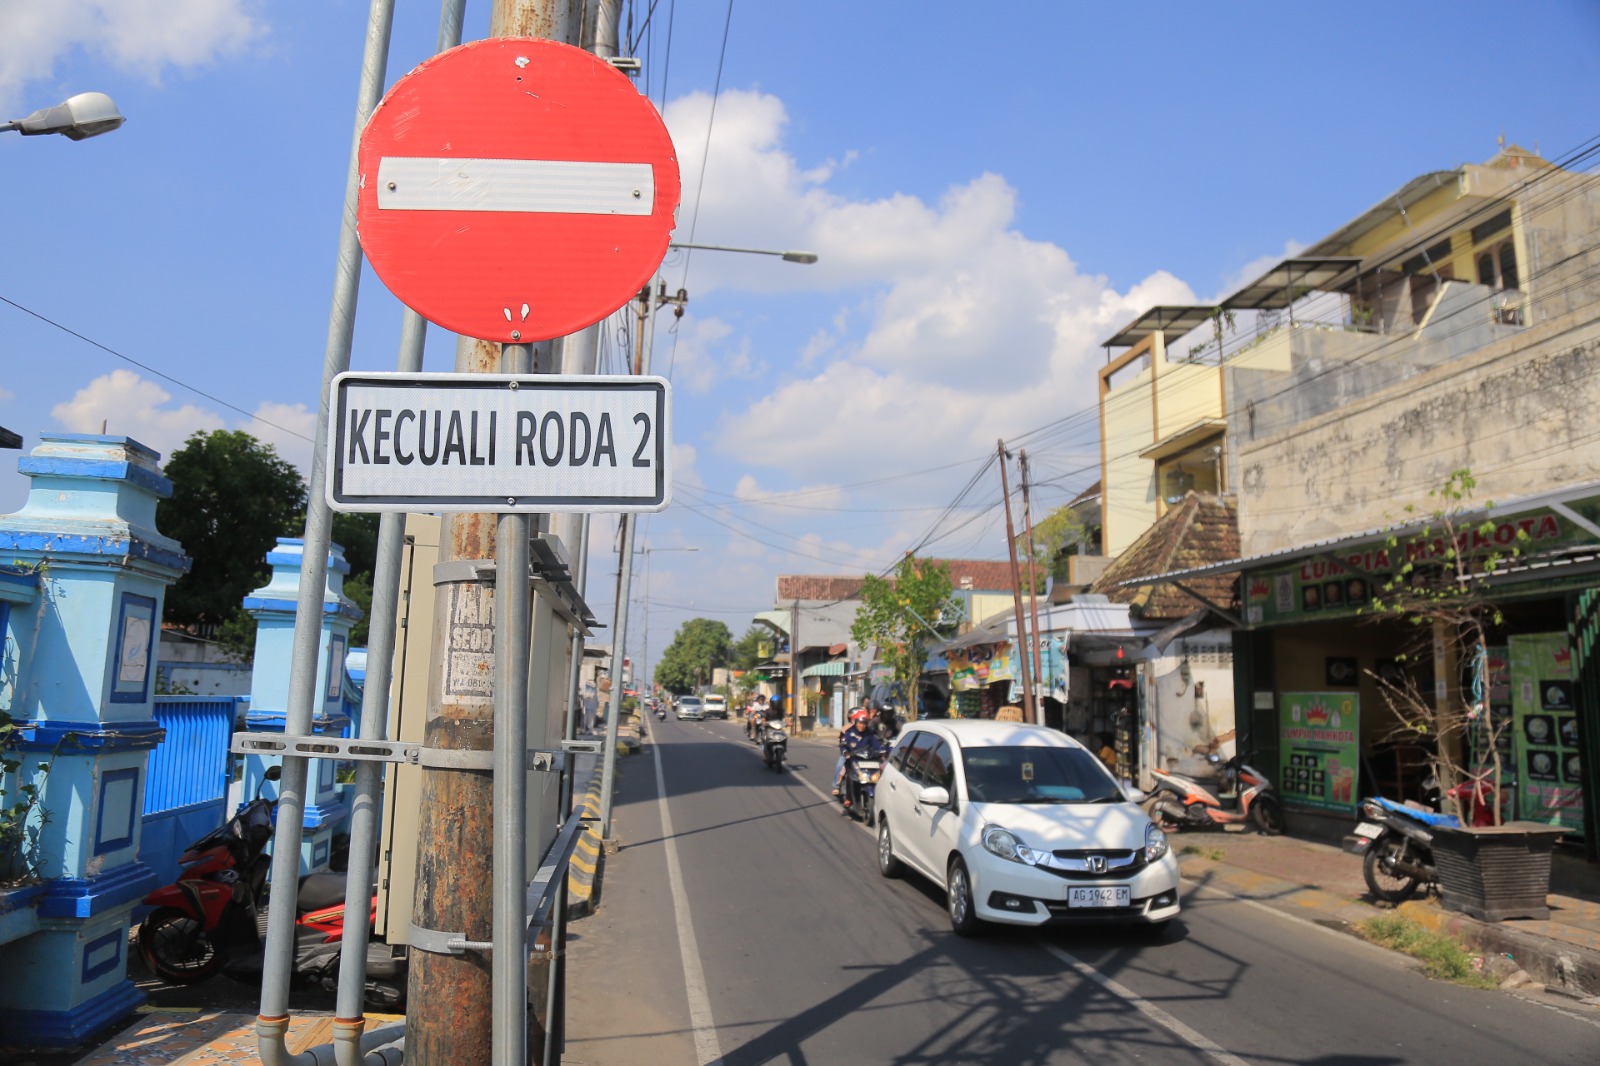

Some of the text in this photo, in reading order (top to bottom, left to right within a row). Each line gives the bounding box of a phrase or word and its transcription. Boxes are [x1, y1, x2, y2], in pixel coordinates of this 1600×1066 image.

[349, 408, 651, 467] KECUALI RODA 2
[1301, 549, 1390, 581] LUMPIA
[1073, 888, 1128, 901] AG 1942 EM
